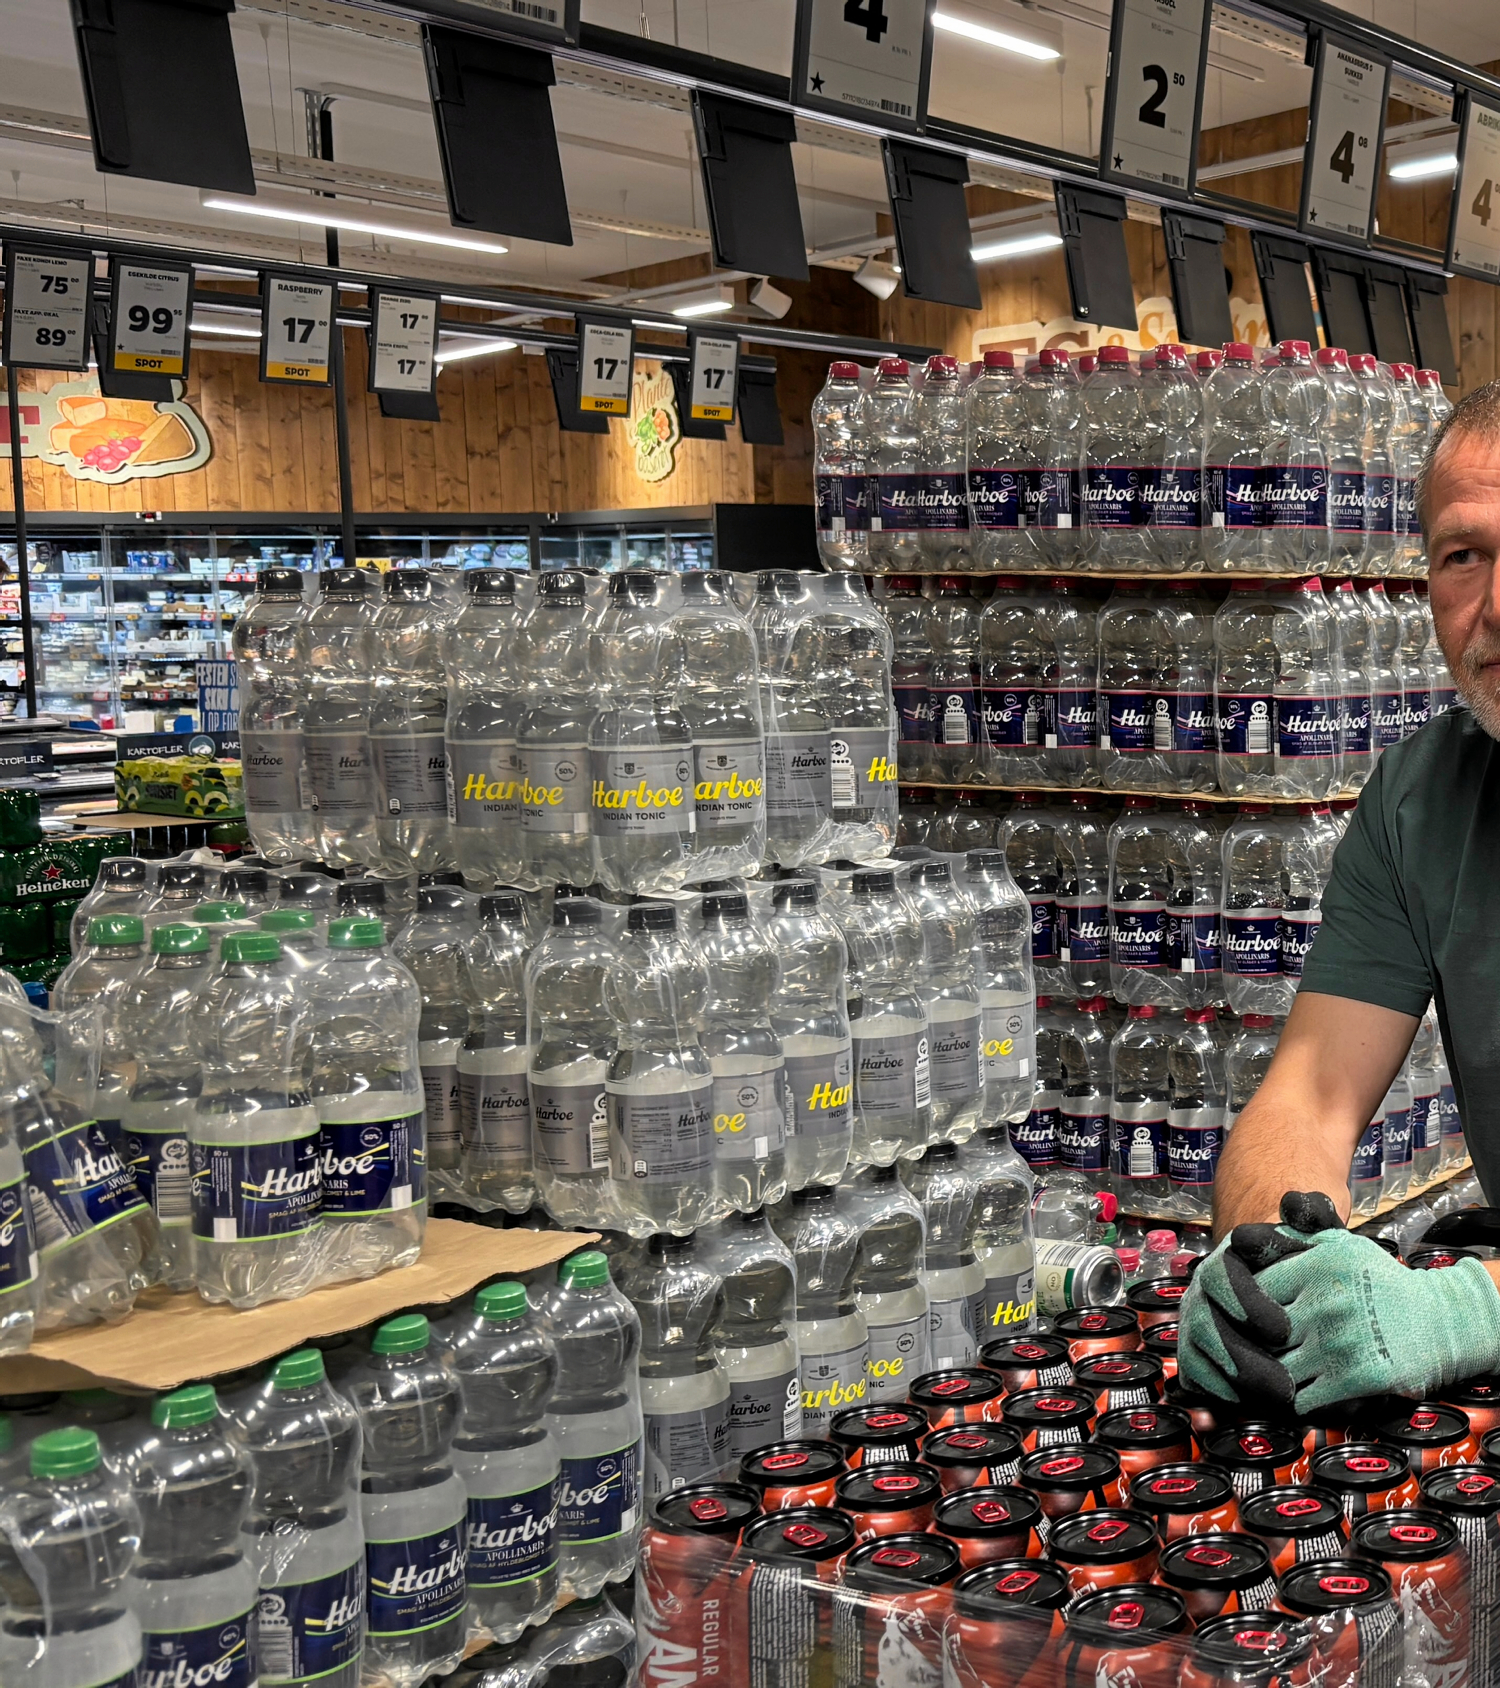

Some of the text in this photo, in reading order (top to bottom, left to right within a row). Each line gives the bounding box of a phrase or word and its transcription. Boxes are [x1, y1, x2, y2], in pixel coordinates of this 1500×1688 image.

[1139, 64, 1185, 128] 2 50
[1330, 130, 1368, 184] 4 08
[1471, 179, 1492, 226] 4
[40, 275, 69, 295] 75
[278, 284, 323, 296] RASPBERRY
[128, 305, 173, 334] 99
[400, 313, 418, 329] 17
[36, 328, 66, 346] 89
[283, 317, 315, 344] 17
[135, 358, 163, 369] SPOT
[285, 367, 310, 377] SPOT
[398, 359, 416, 375] 17
[594, 358, 618, 380] 17
[704, 368, 725, 389] 17
[595, 401, 613, 409] SPOT
[704, 409, 720, 417] SPOT
[969, 489, 1009, 503] arboe
[1082, 484, 1135, 501] Harboe
[1143, 485, 1199, 503] Harboe
[1263, 483, 1319, 501] Harboe
[1288, 713, 1341, 732] Harboe
[127, 745, 184, 757] KARTOFLER
[791, 756, 826, 768] Harboe
[592, 781, 684, 809] Harboe
[695, 772, 763, 800] arboe
[728, 801, 752, 811] TONIC
[603, 811, 666, 821] INDIAN TONIC
[16, 877, 91, 897] Heineken
[1112, 925, 1164, 943] Harboe
[1226, 933, 1281, 951] Harboe
[932, 1039, 971, 1052] Harboe
[861, 1056, 904, 1070] Harboe
[482, 1096, 529, 1109] Harboe
[536, 1106, 574, 1121] Harboe
[1060, 1133, 1100, 1148] arboe
[990, 1299, 1035, 1327] Har
[801, 1378, 866, 1409] arboe
[485, 1540, 545, 1561] APOLLINARIS
[702, 1599, 719, 1676] REGULAR
